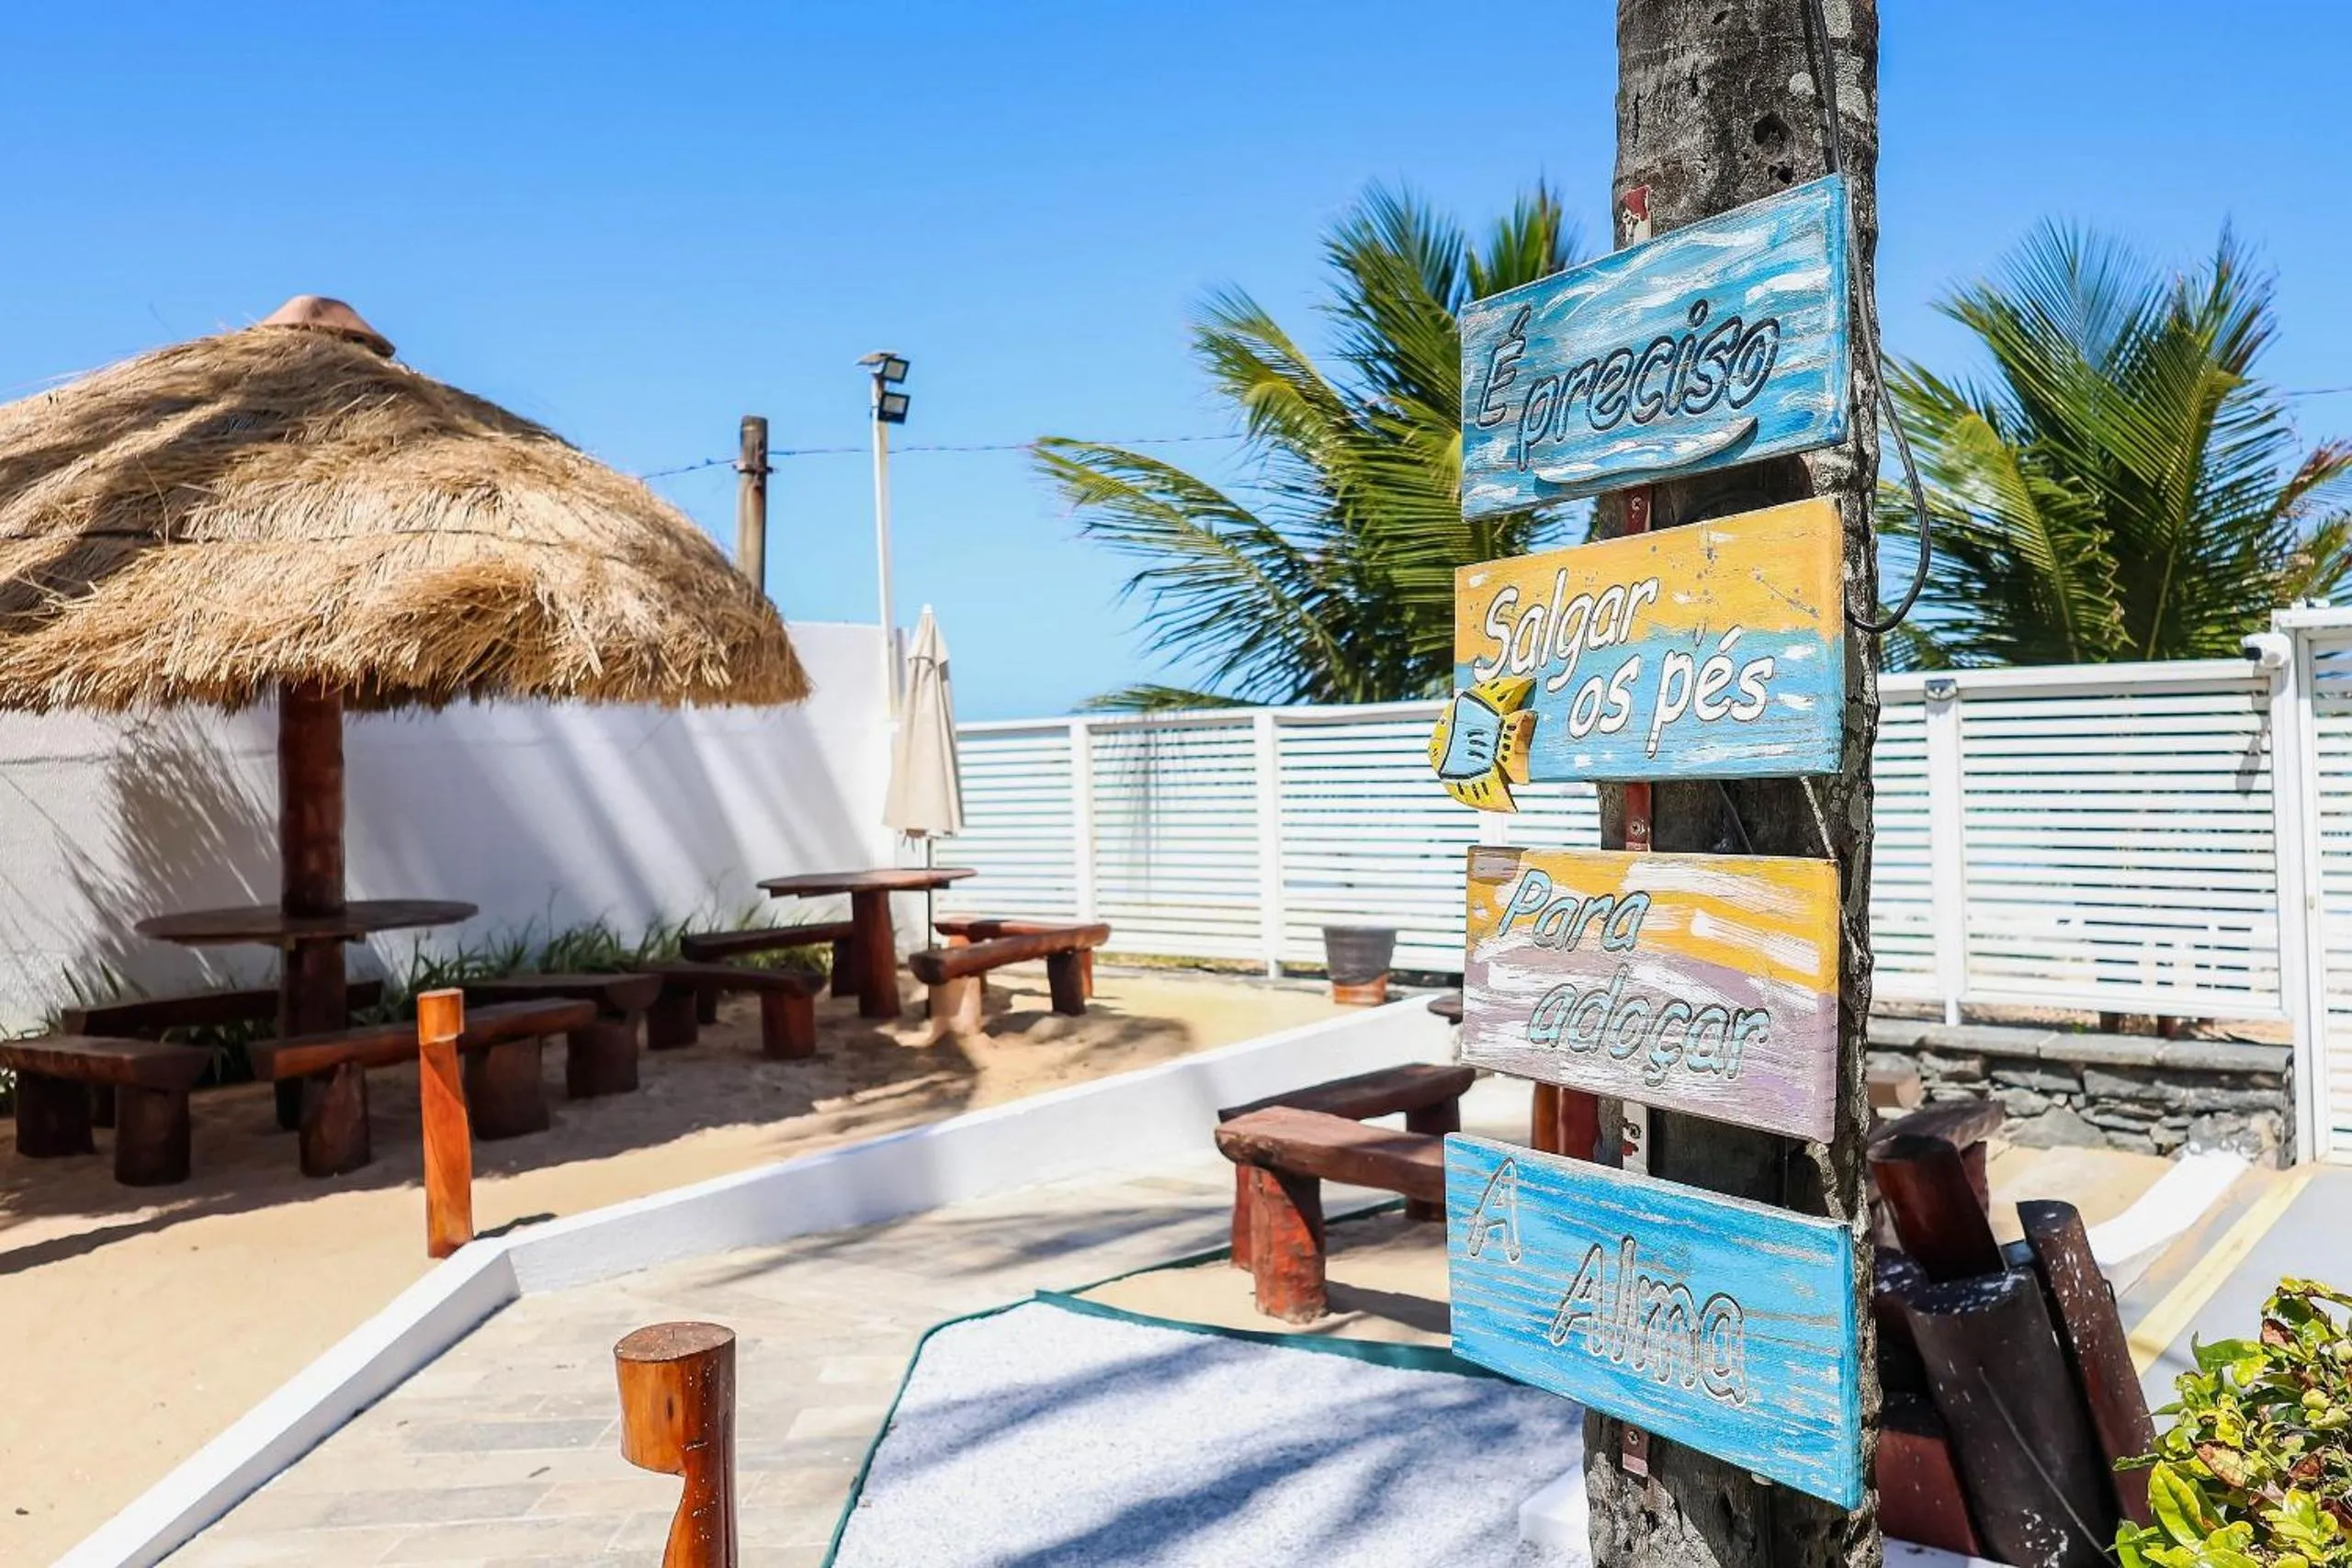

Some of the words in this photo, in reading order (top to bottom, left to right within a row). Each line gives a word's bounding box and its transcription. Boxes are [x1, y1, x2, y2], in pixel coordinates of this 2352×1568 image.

[1476, 304, 1531, 429] É
[1517, 299, 1781, 471] preciso
[1473, 567, 1659, 694] Salgar
[1567, 654, 1641, 739] os
[1645, 625, 1774, 759] pés
[1498, 868, 1651, 953] Para
[1527, 963, 1771, 1087] adoçar
[1468, 1157, 1521, 1262] A
[1550, 1235, 1747, 1407] Alma
